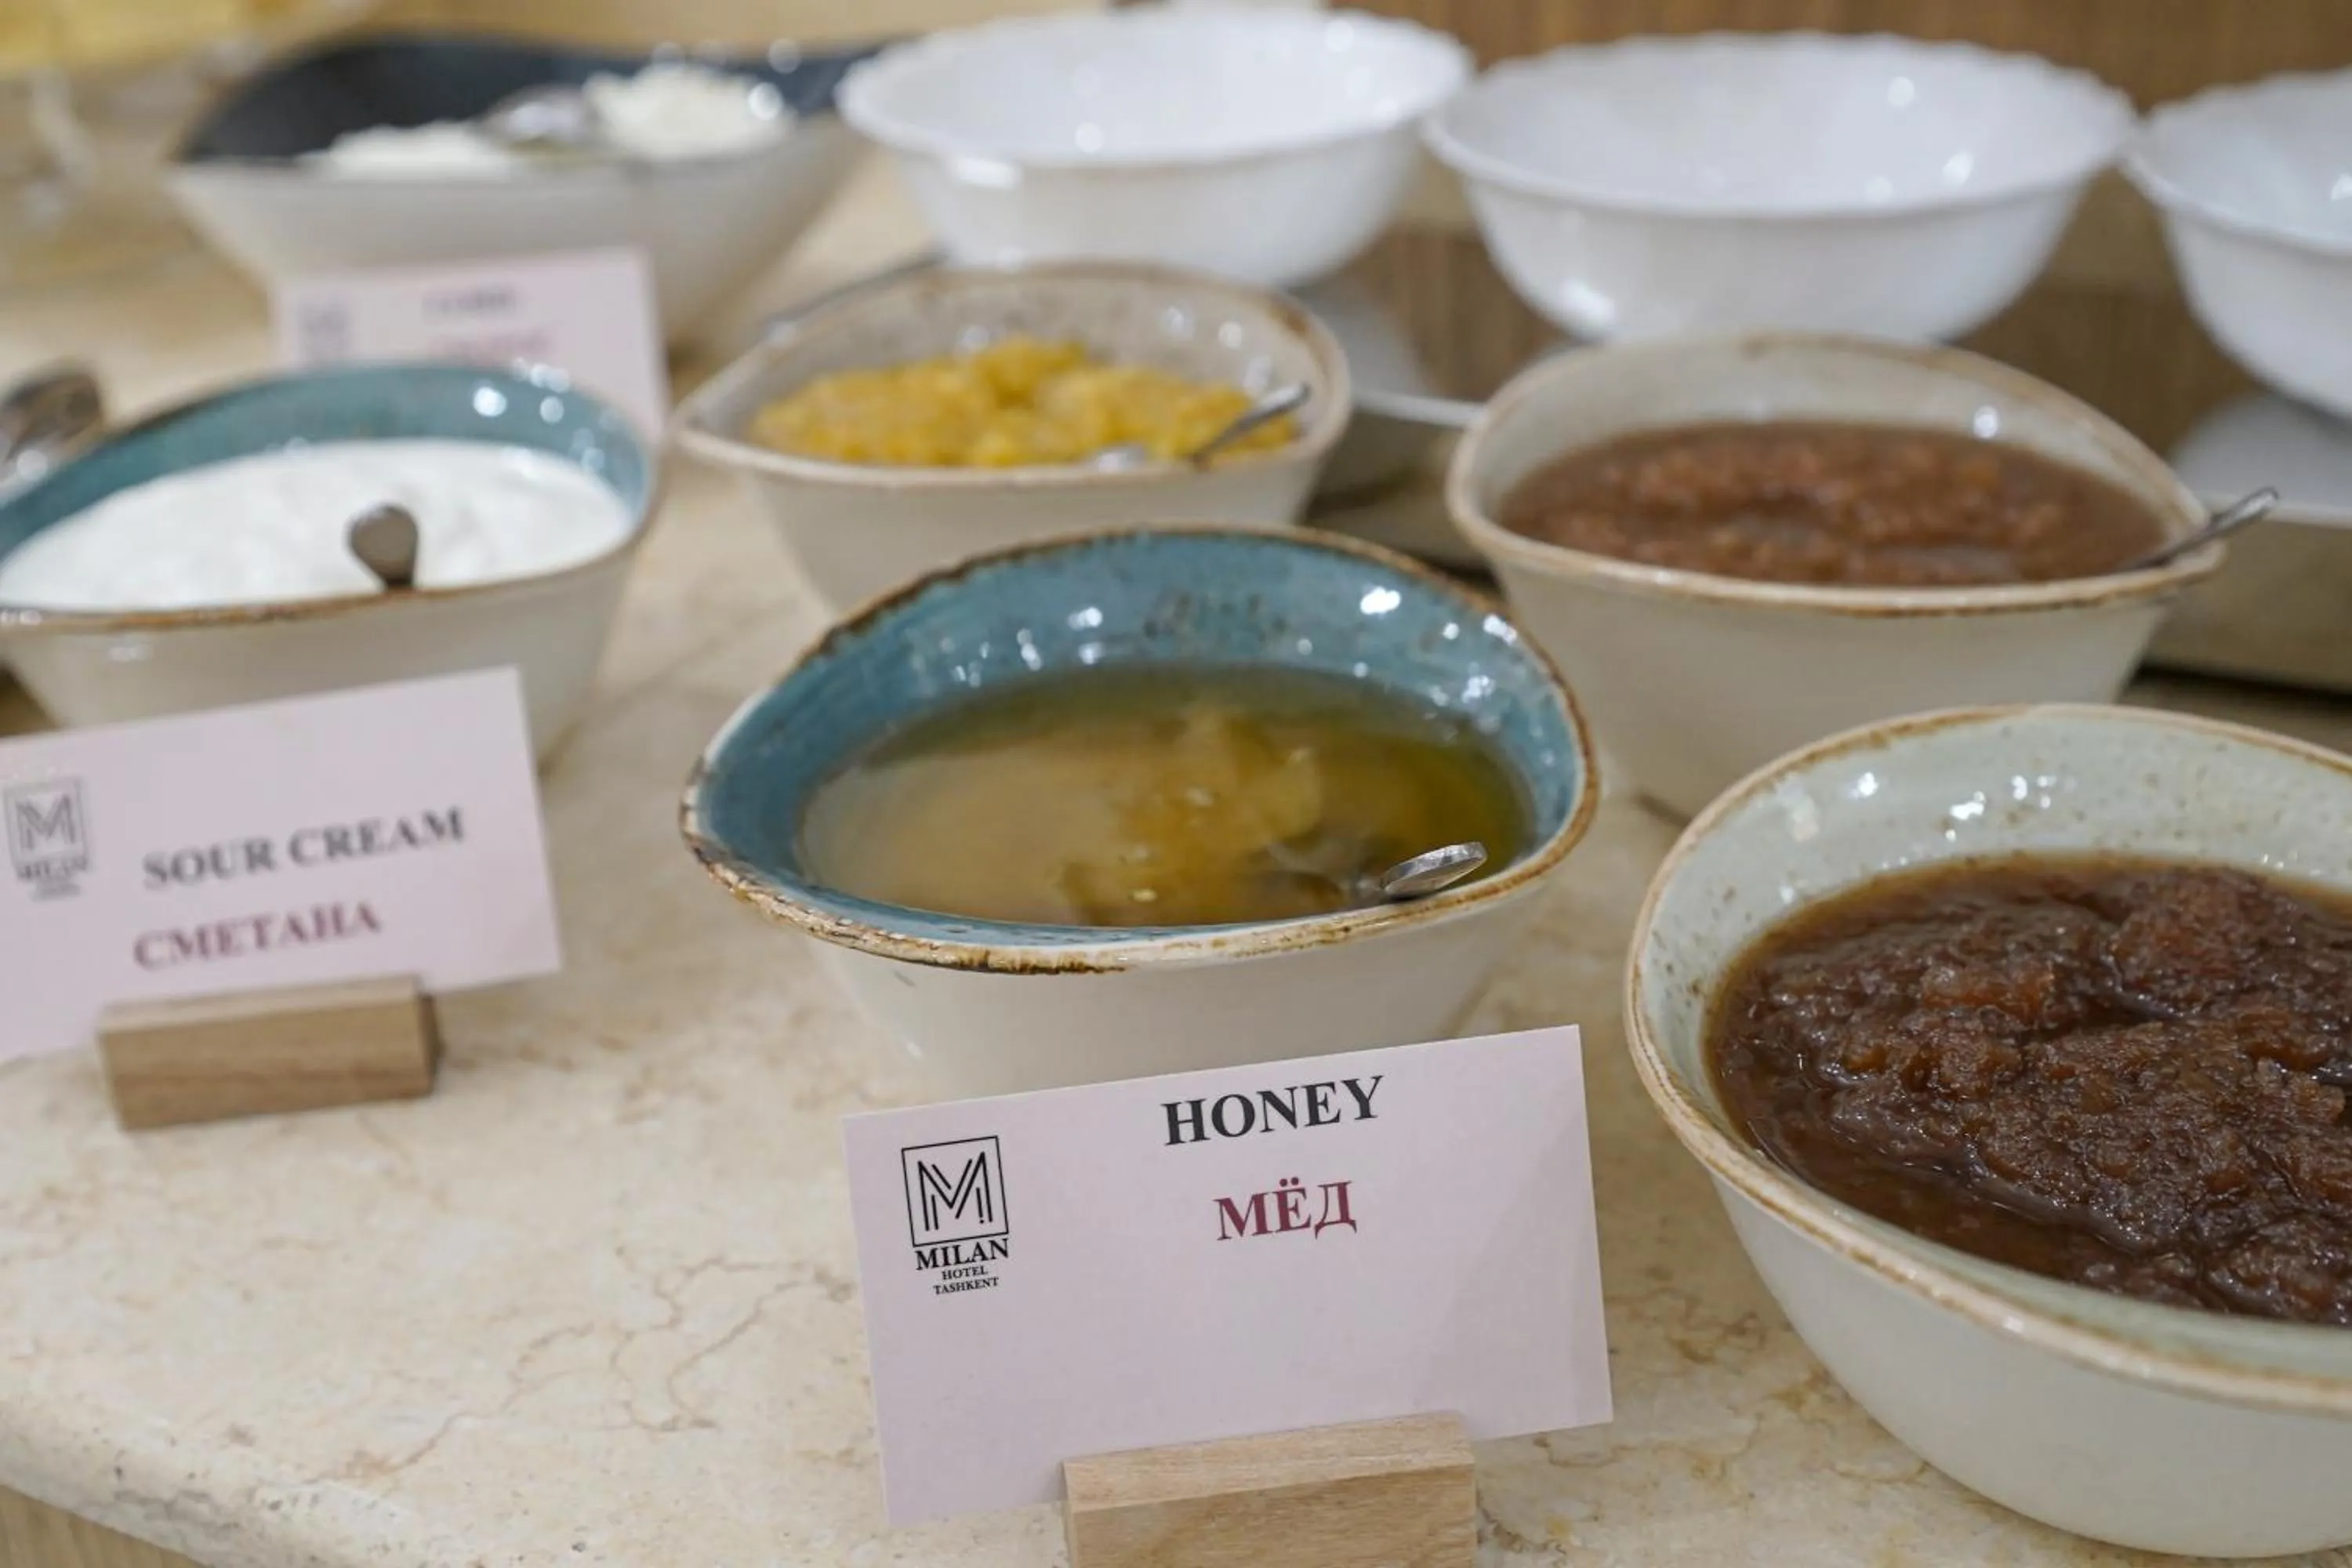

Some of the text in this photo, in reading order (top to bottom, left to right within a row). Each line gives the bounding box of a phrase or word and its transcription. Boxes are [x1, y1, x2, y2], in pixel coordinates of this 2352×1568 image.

[142, 837, 278, 891] SOUR
[285, 804, 463, 868] CREAM
[132, 899, 383, 972] СМЕТАНА
[1160, 1075, 1385, 1147] HONEY
[1212, 1176, 1357, 1241] МЁД
[914, 1237, 1009, 1271] MILAN
[932, 1276, 1000, 1295] TASHKENT
[942, 1265, 988, 1281] HOTEL
